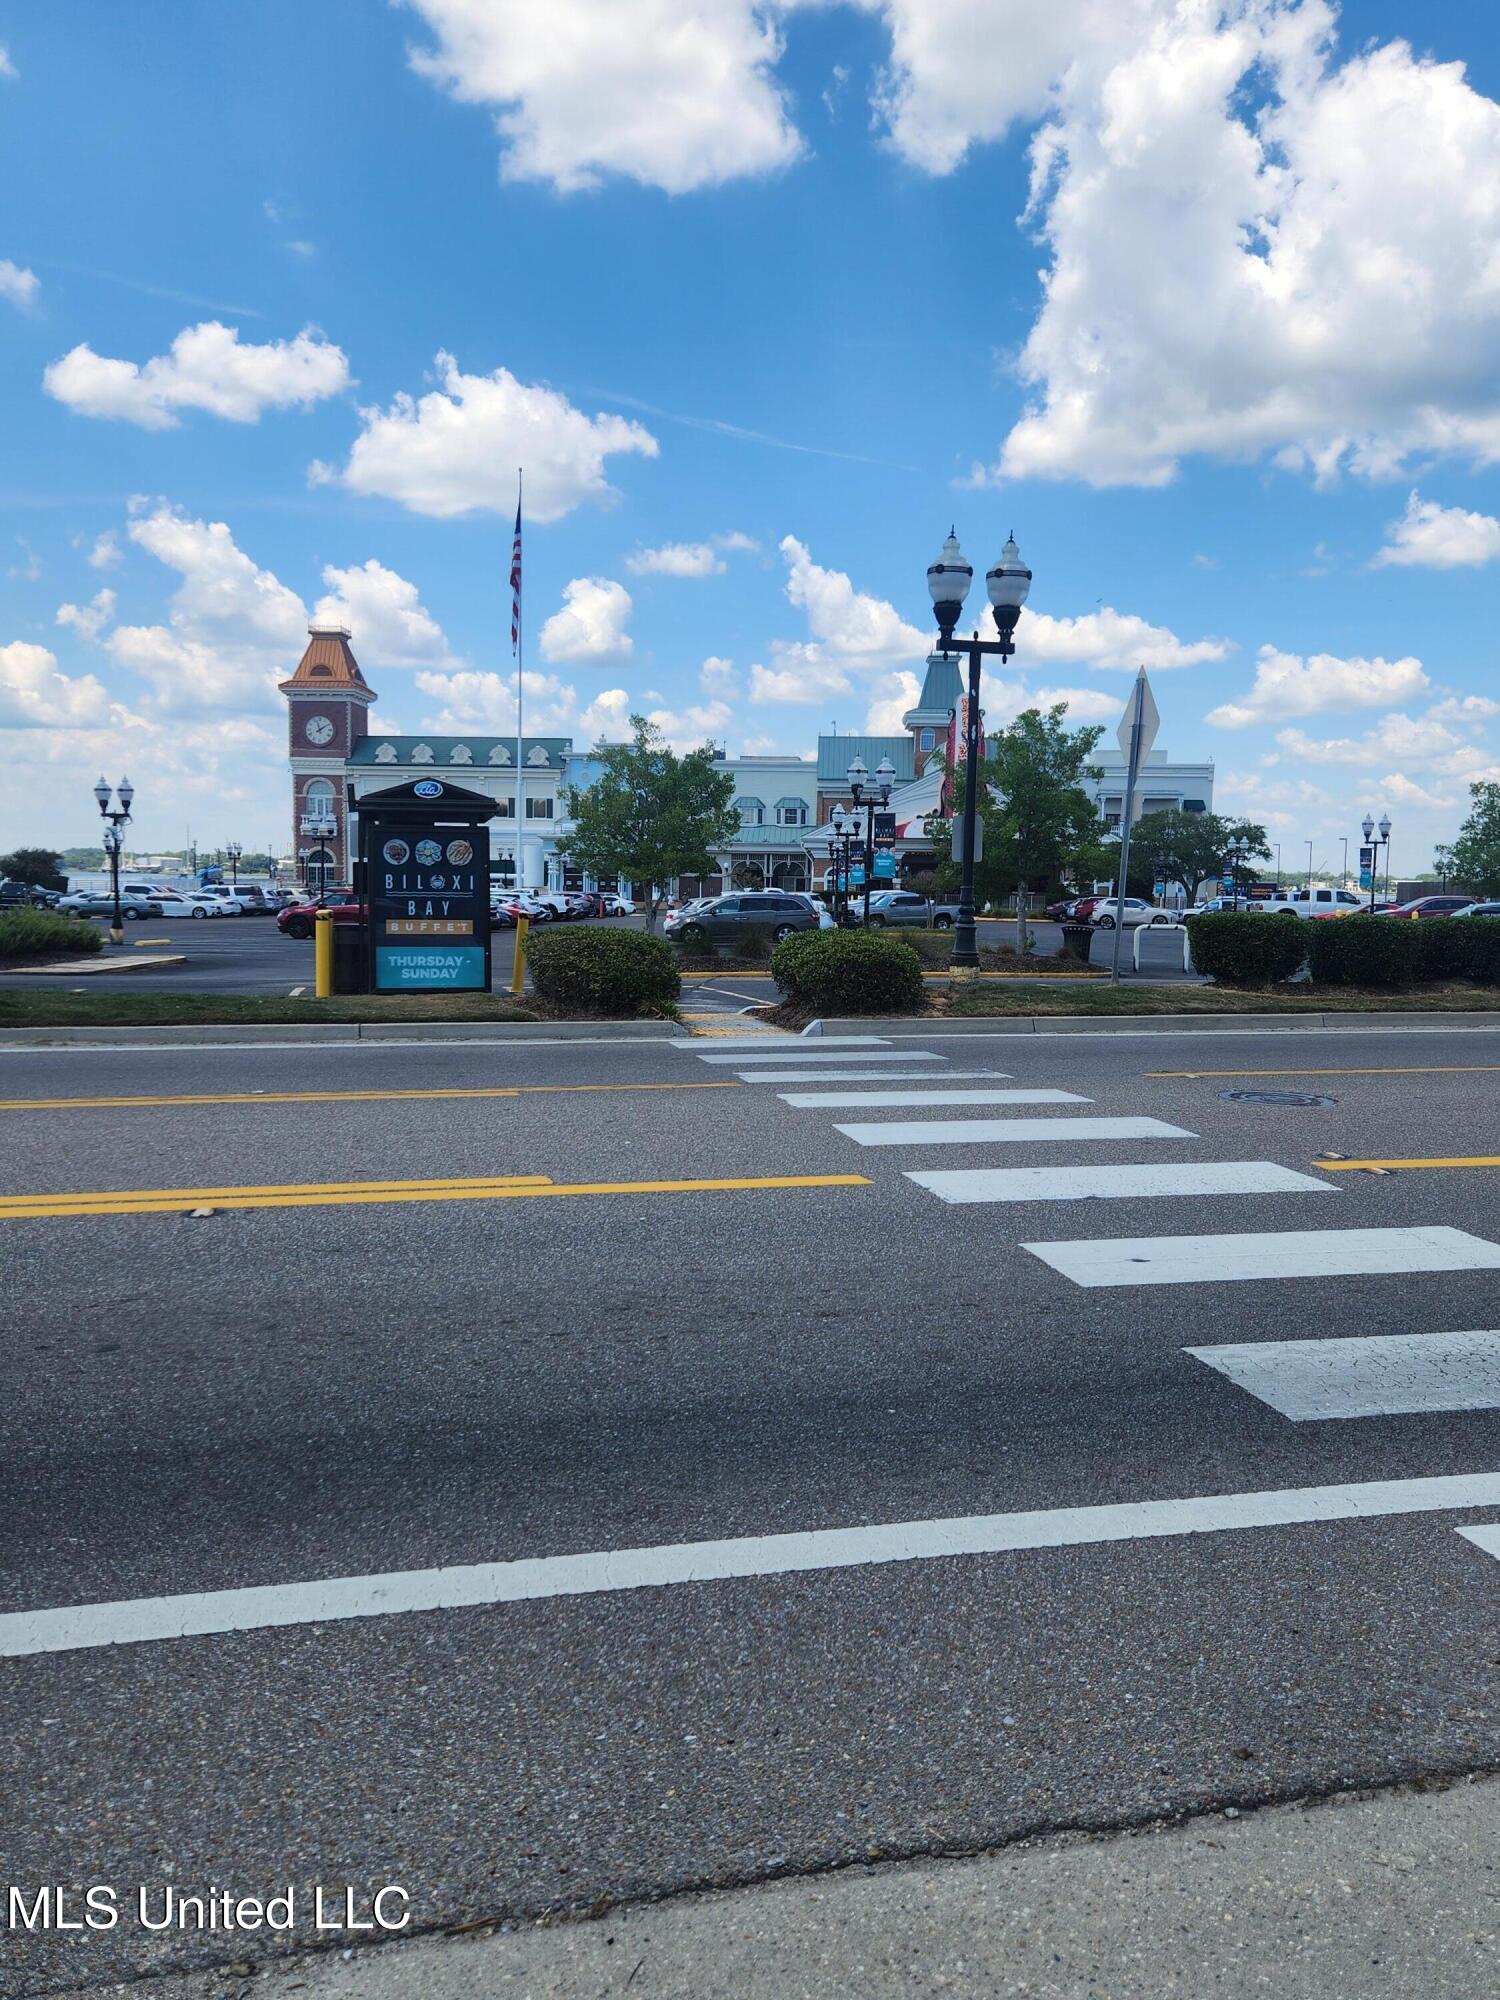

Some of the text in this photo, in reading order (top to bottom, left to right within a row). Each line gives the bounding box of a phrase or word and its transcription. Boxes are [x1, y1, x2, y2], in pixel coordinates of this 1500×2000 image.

[408, 900, 450, 916] BAY
[391, 923, 468, 931] BUFFET
[388, 955, 464, 967] THURSDAY
[401, 967, 459, 979] SUNDAY
